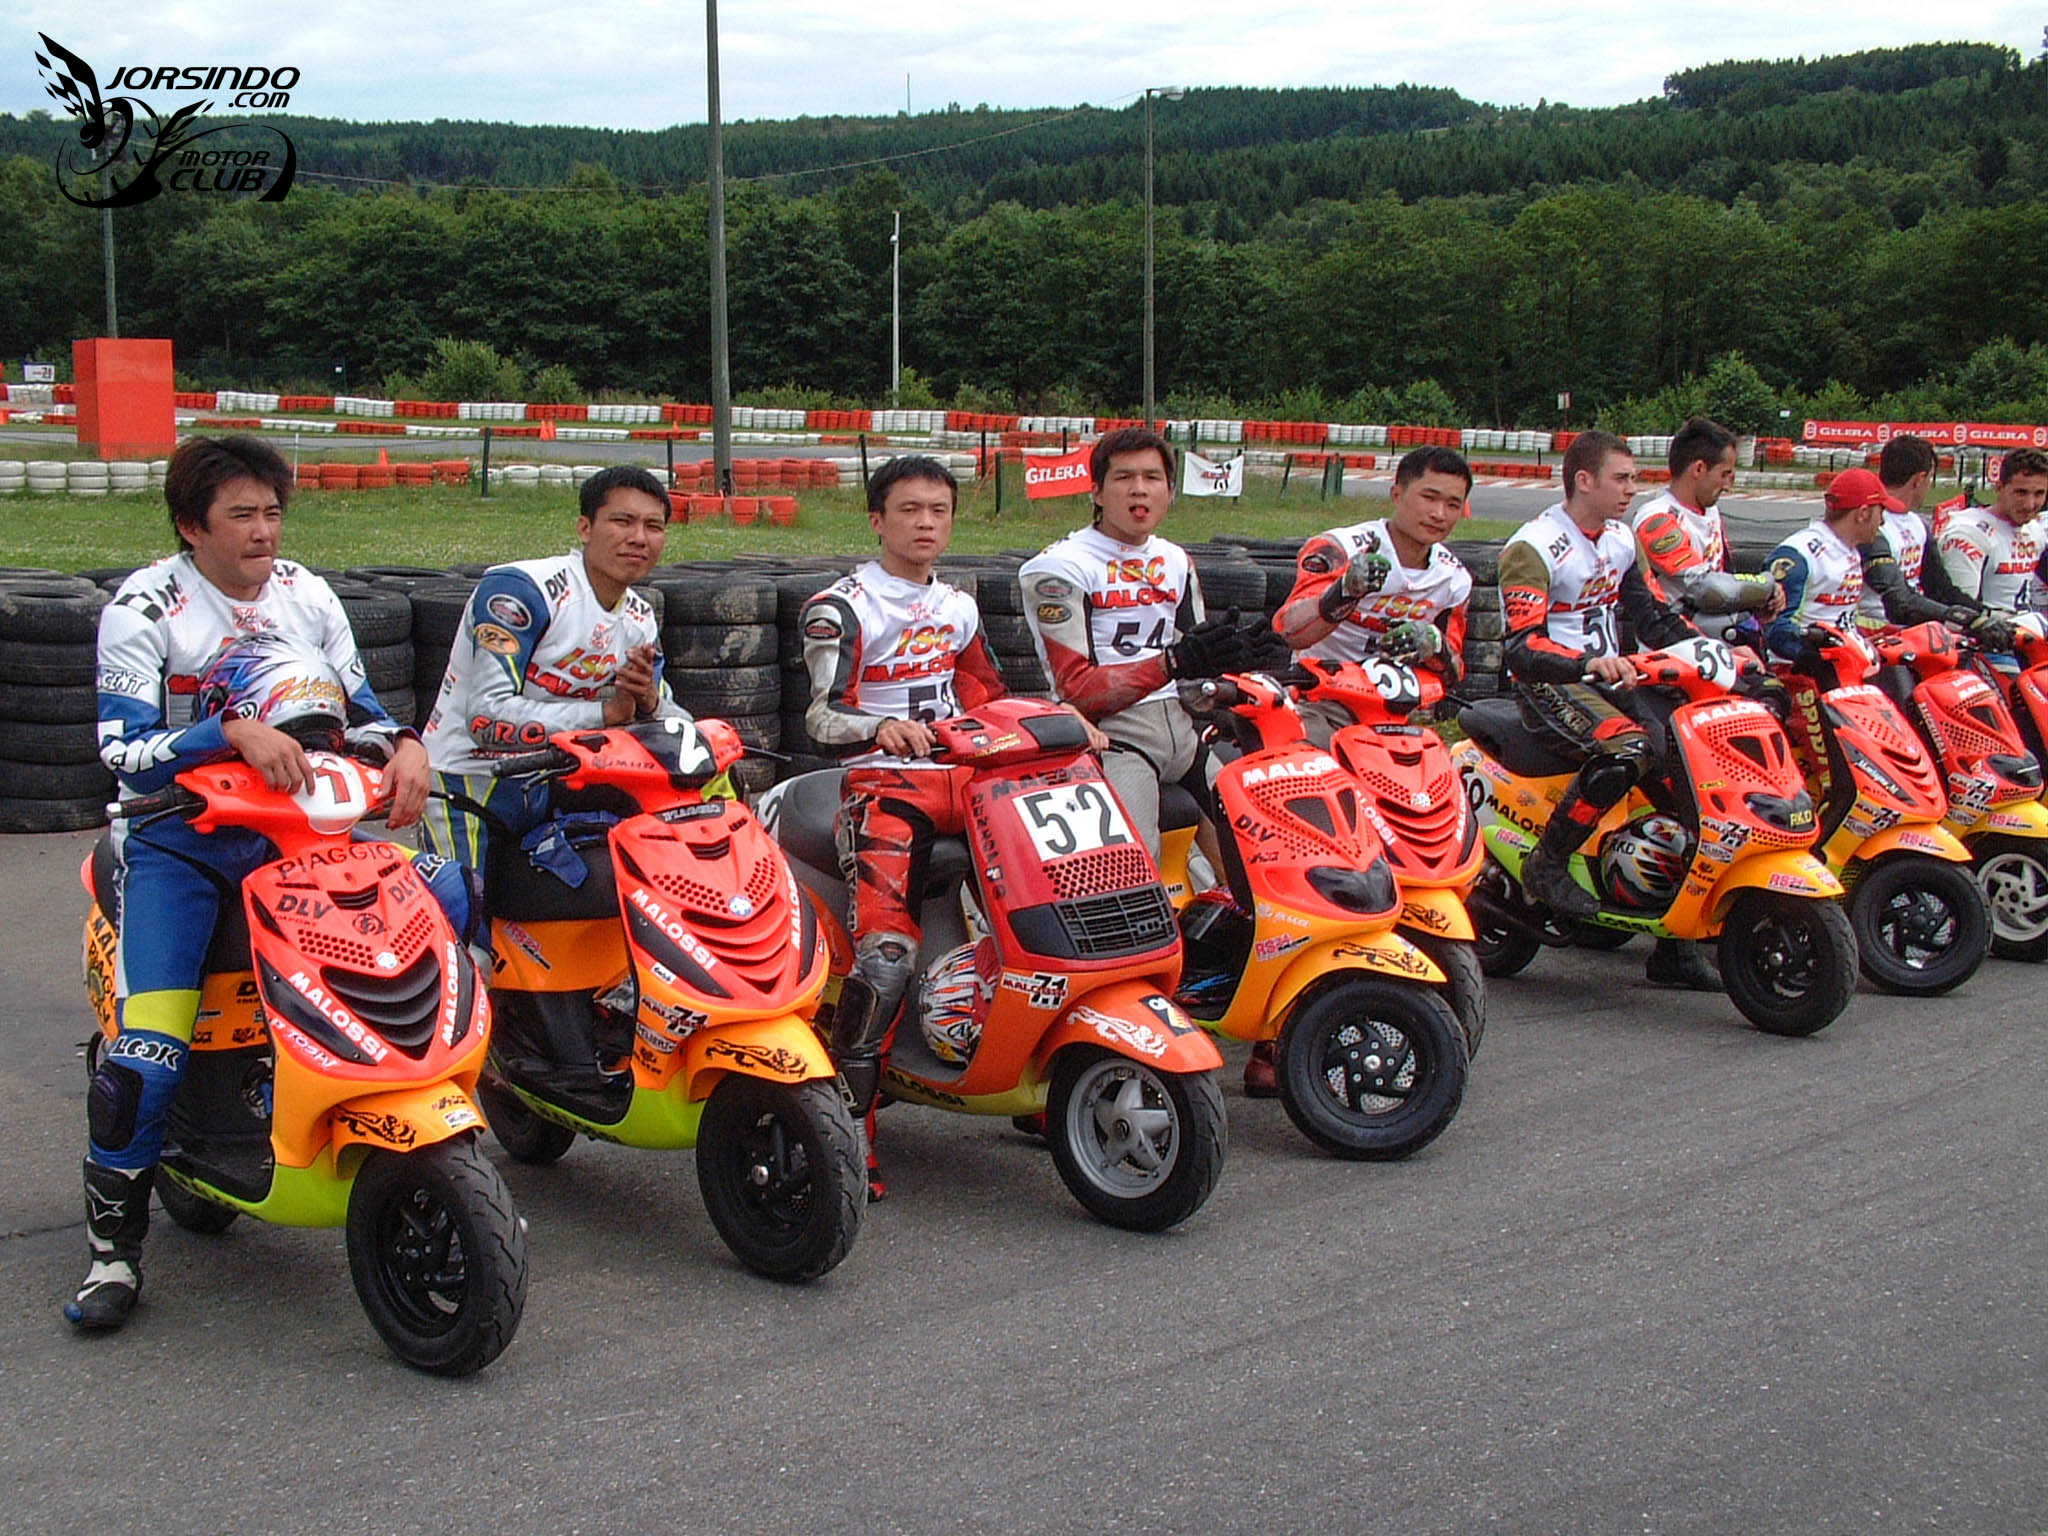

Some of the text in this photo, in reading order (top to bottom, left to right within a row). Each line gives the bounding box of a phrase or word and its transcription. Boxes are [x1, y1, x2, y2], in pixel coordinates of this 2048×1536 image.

[1819, 427, 1873, 438] GILERA
[1969, 430, 2028, 441] GILERA
[1025, 463, 1089, 485] GILERA
[1106, 555, 1166, 587] ISC
[895, 623, 956, 658] ISC
[1692, 639, 1735, 681] 50
[663, 716, 711, 775] 2
[1234, 813, 1277, 842] DLV
[275, 844, 395, 881] PIAGGIO
[275, 893, 335, 919] DLV
[631, 888, 718, 971] MALOSSI
[441, 940, 459, 1048] MALOSSI
[288, 971, 389, 1063] MALOSSI
[108, 1034, 183, 1071] LOOK
